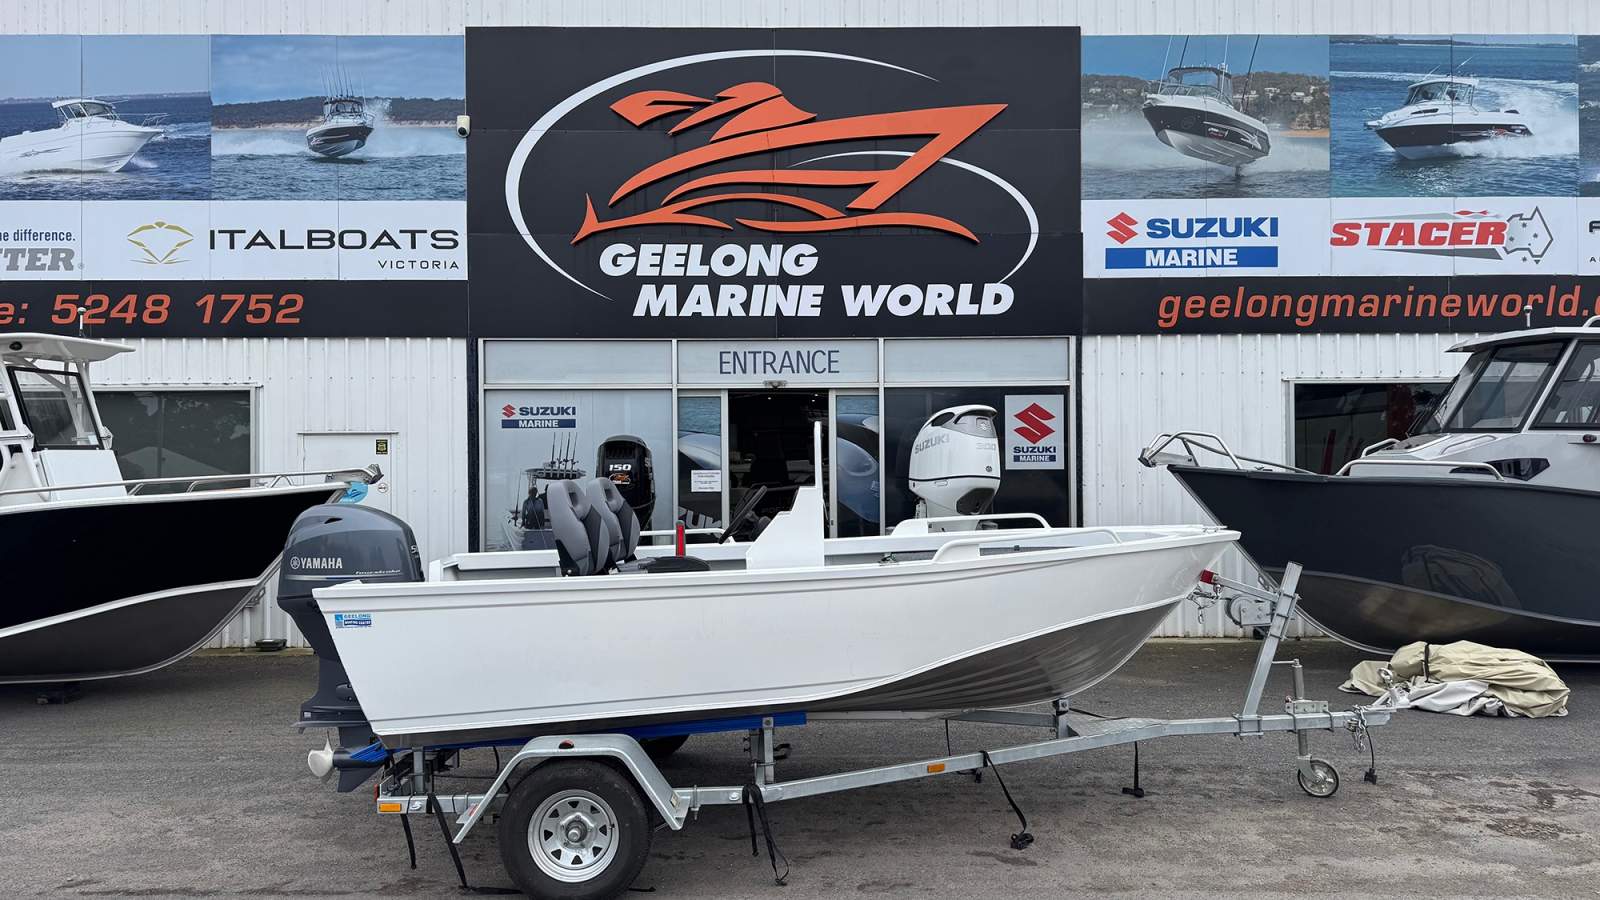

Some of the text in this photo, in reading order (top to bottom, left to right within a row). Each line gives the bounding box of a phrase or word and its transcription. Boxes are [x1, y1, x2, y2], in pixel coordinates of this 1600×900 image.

[13, 229, 76, 241] difference.
[1146, 217, 1278, 238] SUZUKI
[1330, 221, 1508, 246] STACER
[210, 229, 459, 250] ITALBOATS
[0, 248, 75, 271] TER
[378, 260, 459, 270] VICTORIA
[600, 243, 818, 277] GEELONG
[1145, 248, 1238, 267] MARINE
[51, 294, 170, 324] 5248
[195, 294, 304, 324] 1752
[633, 282, 1014, 317] MARINE WORLD
[719, 350, 840, 375] ENTRANCE
[519, 406, 576, 416] SUZUKI
[518, 420, 559, 428] MARINE
[914, 433, 950, 454] SUZUKI
[300, 558, 343, 569] YAMAHA
